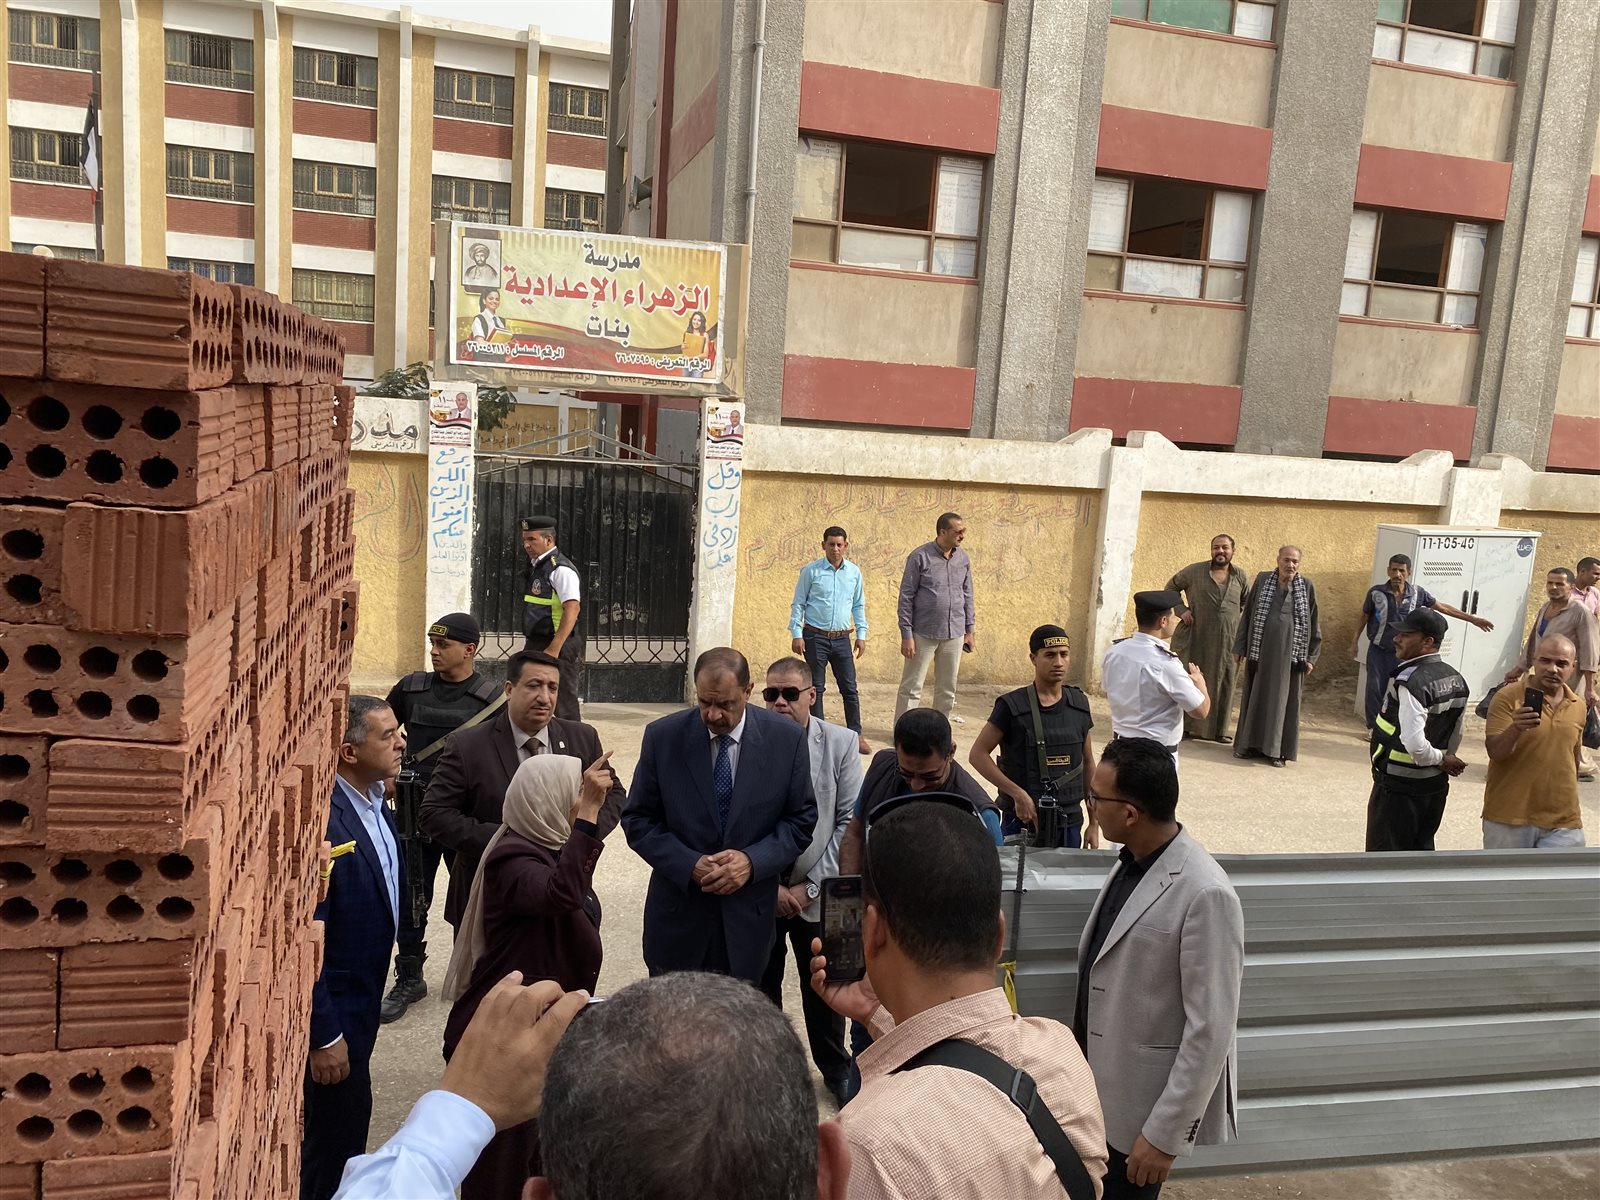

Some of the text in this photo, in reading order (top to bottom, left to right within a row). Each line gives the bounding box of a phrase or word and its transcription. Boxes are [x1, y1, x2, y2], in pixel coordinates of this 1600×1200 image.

[583, 243, 641, 273] مدرسة
[503, 265, 709, 316] الزهراء الإعدادية
[586, 315, 630, 346] بنات
[512, 344, 540, 357] المسلسل
[541, 346, 564, 359] الرقم
[689, 358, 711, 371] الرقم
[351, 412, 419, 443] مدر
[435, 448, 470, 467] يرفع
[437, 467, 466, 482] الله
[707, 461, 741, 490] وقل
[705, 494, 739, 518] رب
[433, 518, 465, 548] منكم
[1422, 537, 1475, 549] 11-1-05-40
